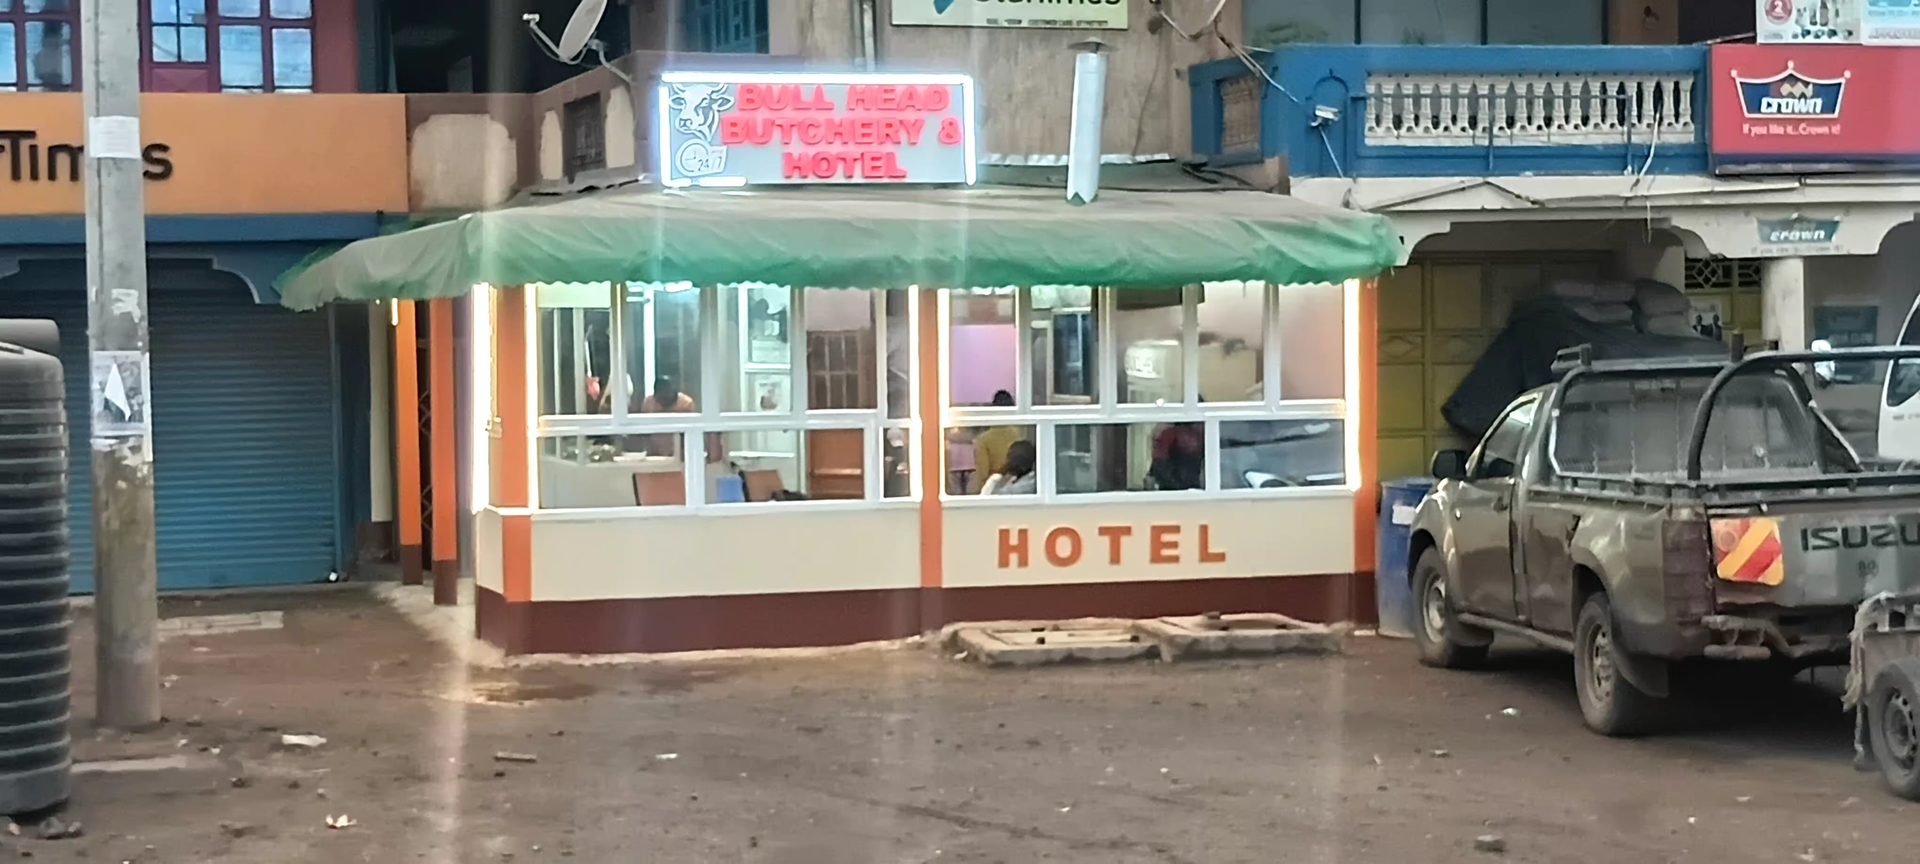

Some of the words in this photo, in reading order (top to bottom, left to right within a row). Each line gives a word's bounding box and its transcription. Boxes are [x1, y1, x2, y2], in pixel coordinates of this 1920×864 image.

[737, 84, 834, 111] BULL
[847, 84, 950, 112] HEAD
[1760, 96, 1823, 113] crown
[720, 117, 925, 145] BUTCHERY
[938, 117, 962, 145] &
[783, 152, 907, 179] HOTEL
[1769, 229, 1826, 241] crown
[998, 523, 1227, 569] HOTEL
[1801, 522, 1920, 552] ISUZU
